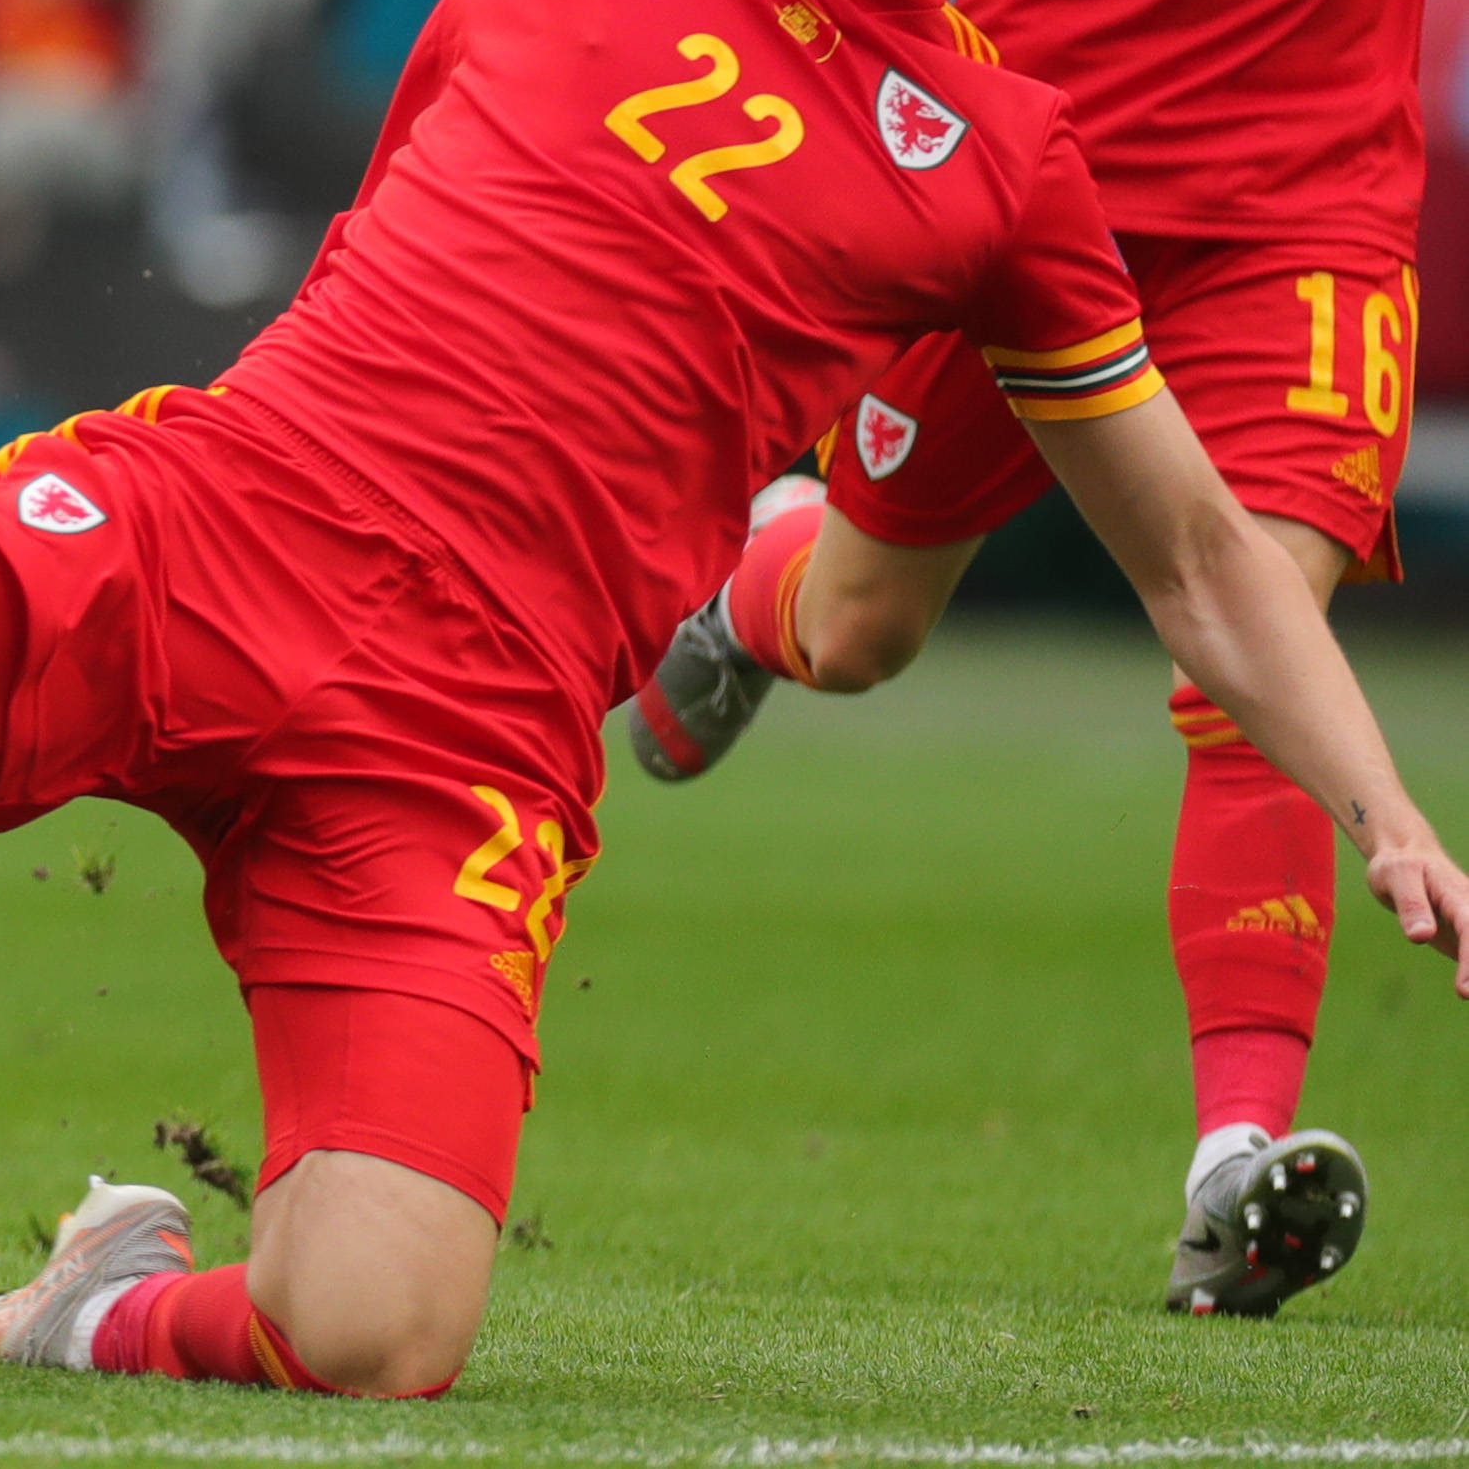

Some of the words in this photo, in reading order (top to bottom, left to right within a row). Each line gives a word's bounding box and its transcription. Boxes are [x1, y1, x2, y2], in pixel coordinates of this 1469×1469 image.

[603, 32, 805, 223] 22
[1285, 272, 1402, 439] 16
[452, 784, 566, 964] 22
